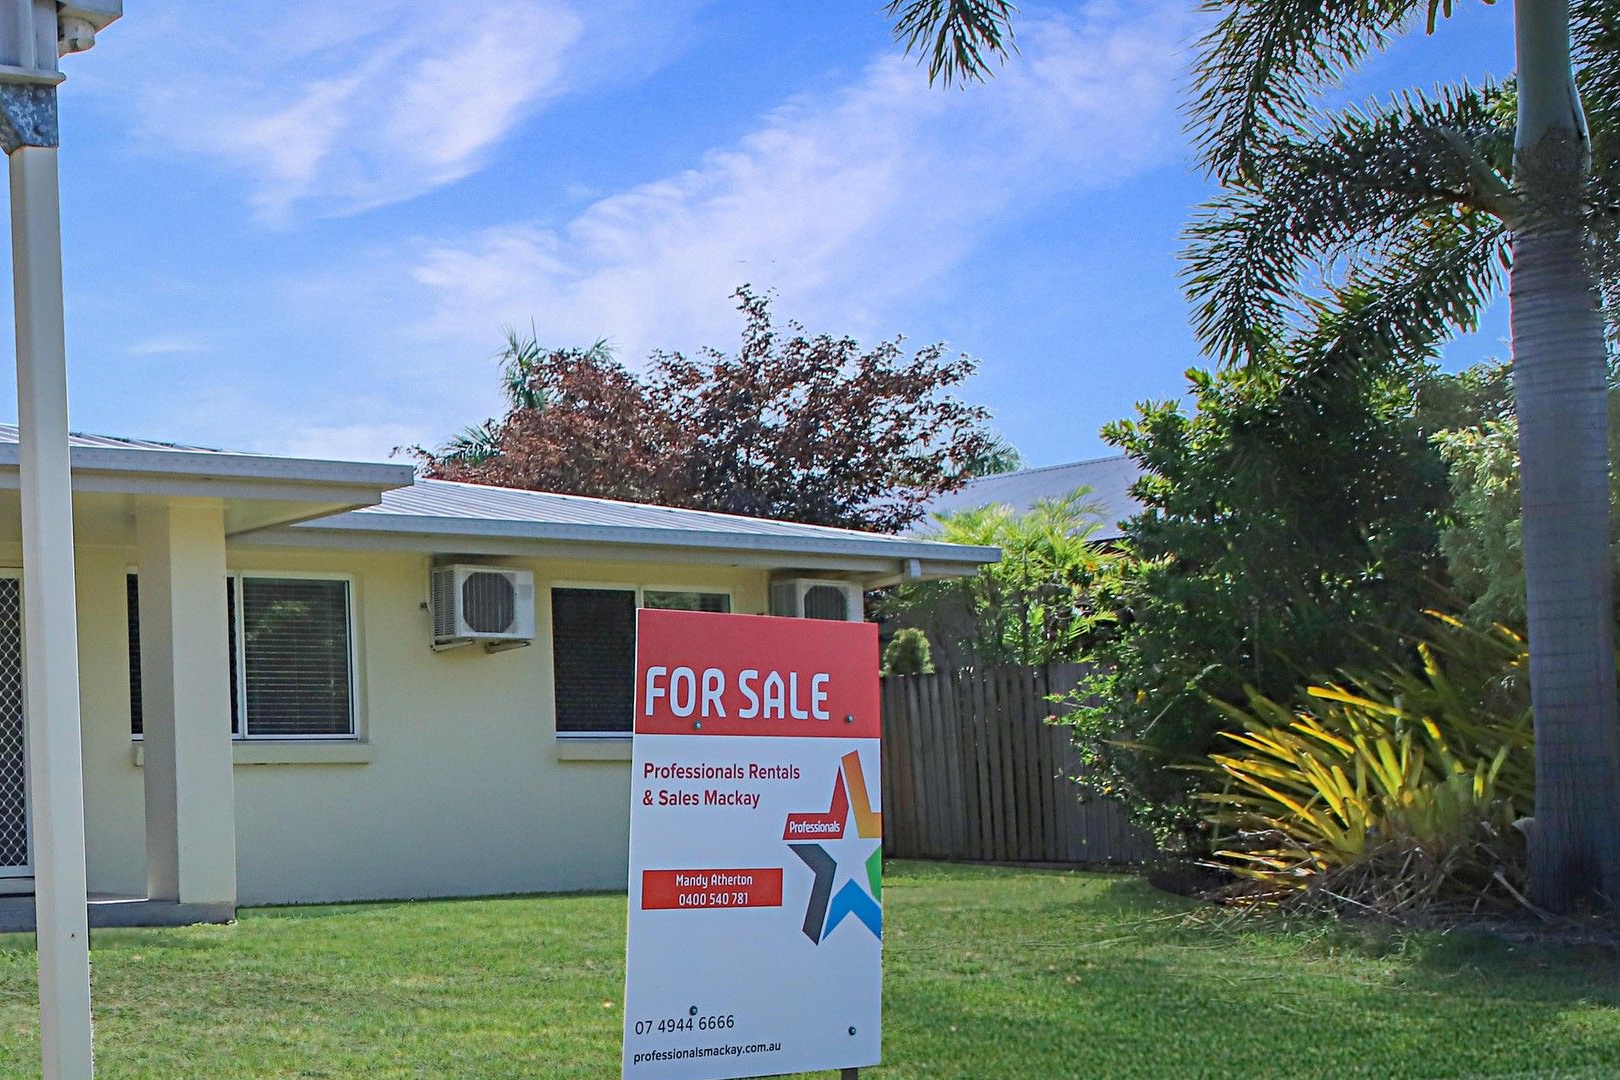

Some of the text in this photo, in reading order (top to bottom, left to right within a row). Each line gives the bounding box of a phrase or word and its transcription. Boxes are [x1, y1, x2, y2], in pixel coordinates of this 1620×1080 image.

[644, 666, 830, 721] FOR SALE
[643, 762, 800, 780] Professionals Rentals
[642, 790, 761, 809] & Sales Mackay
[789, 820, 840, 834] Professionals
[675, 874, 753, 889] Mandy Atherton
[679, 892, 748, 906] 0400 540 781
[634, 1014, 735, 1035] 07 4944 6666
[633, 1042, 782, 1065] professionalsmackay.com.au
